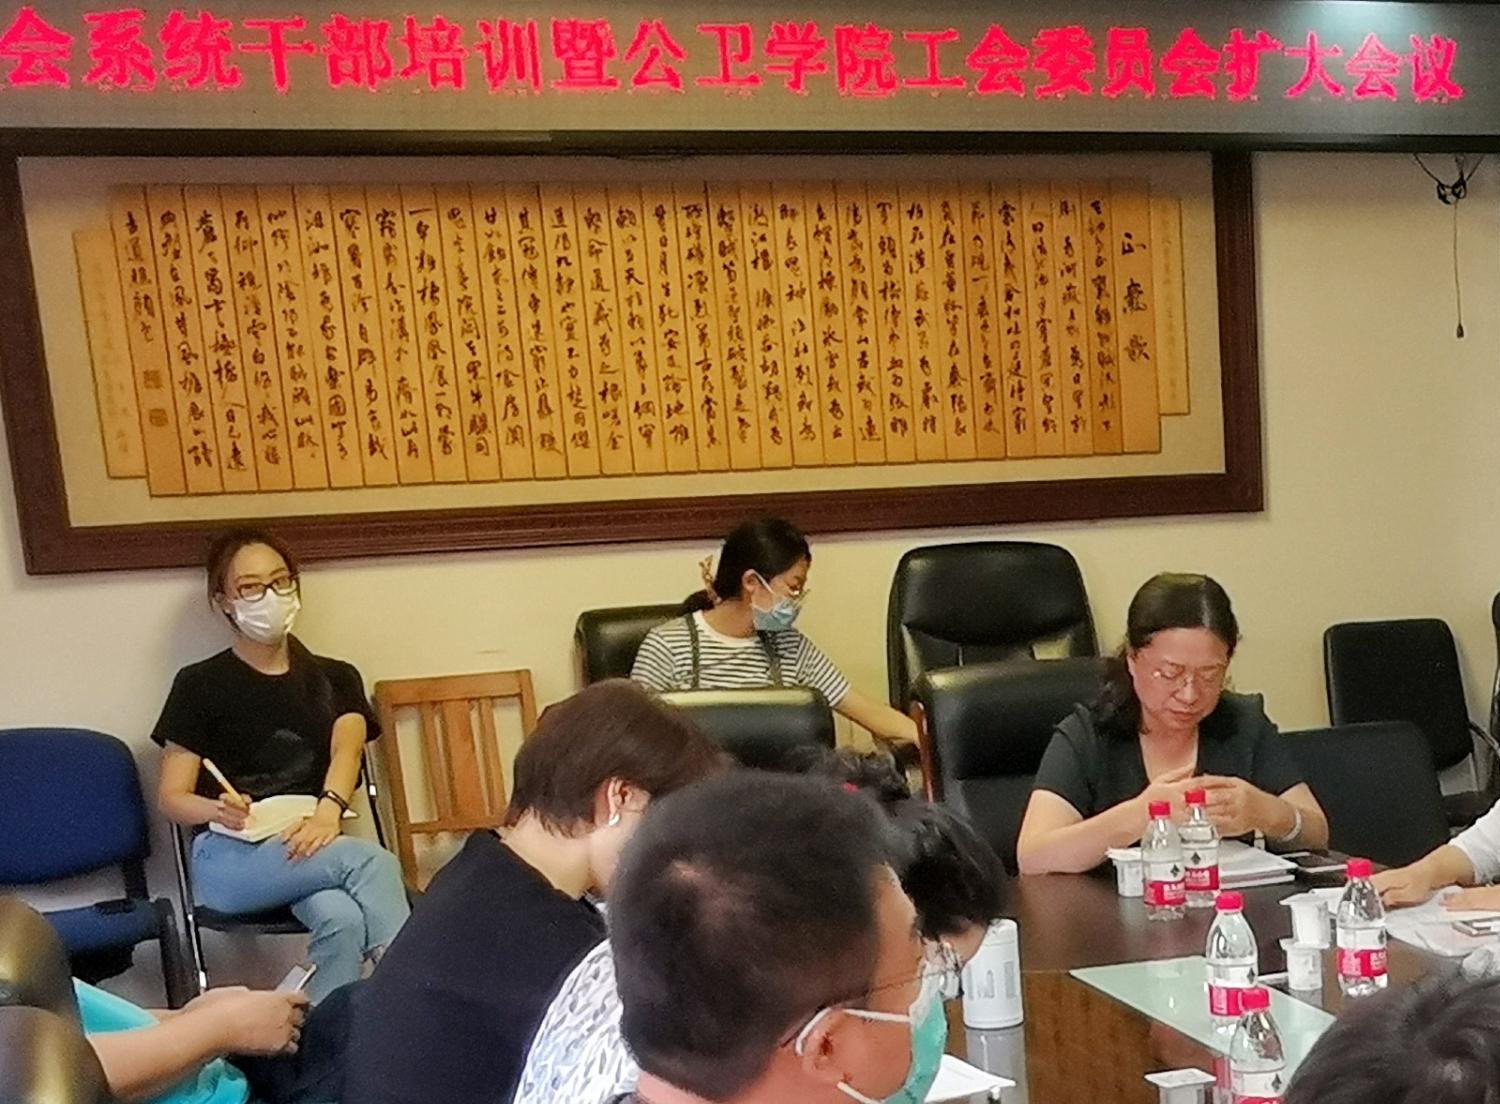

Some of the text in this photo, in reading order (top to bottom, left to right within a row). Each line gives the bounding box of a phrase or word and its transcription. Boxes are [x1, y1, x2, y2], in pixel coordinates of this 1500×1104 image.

[0, 6, 1463, 99] 会系统干部培训暨公卫学院工会委员会扩大会议
